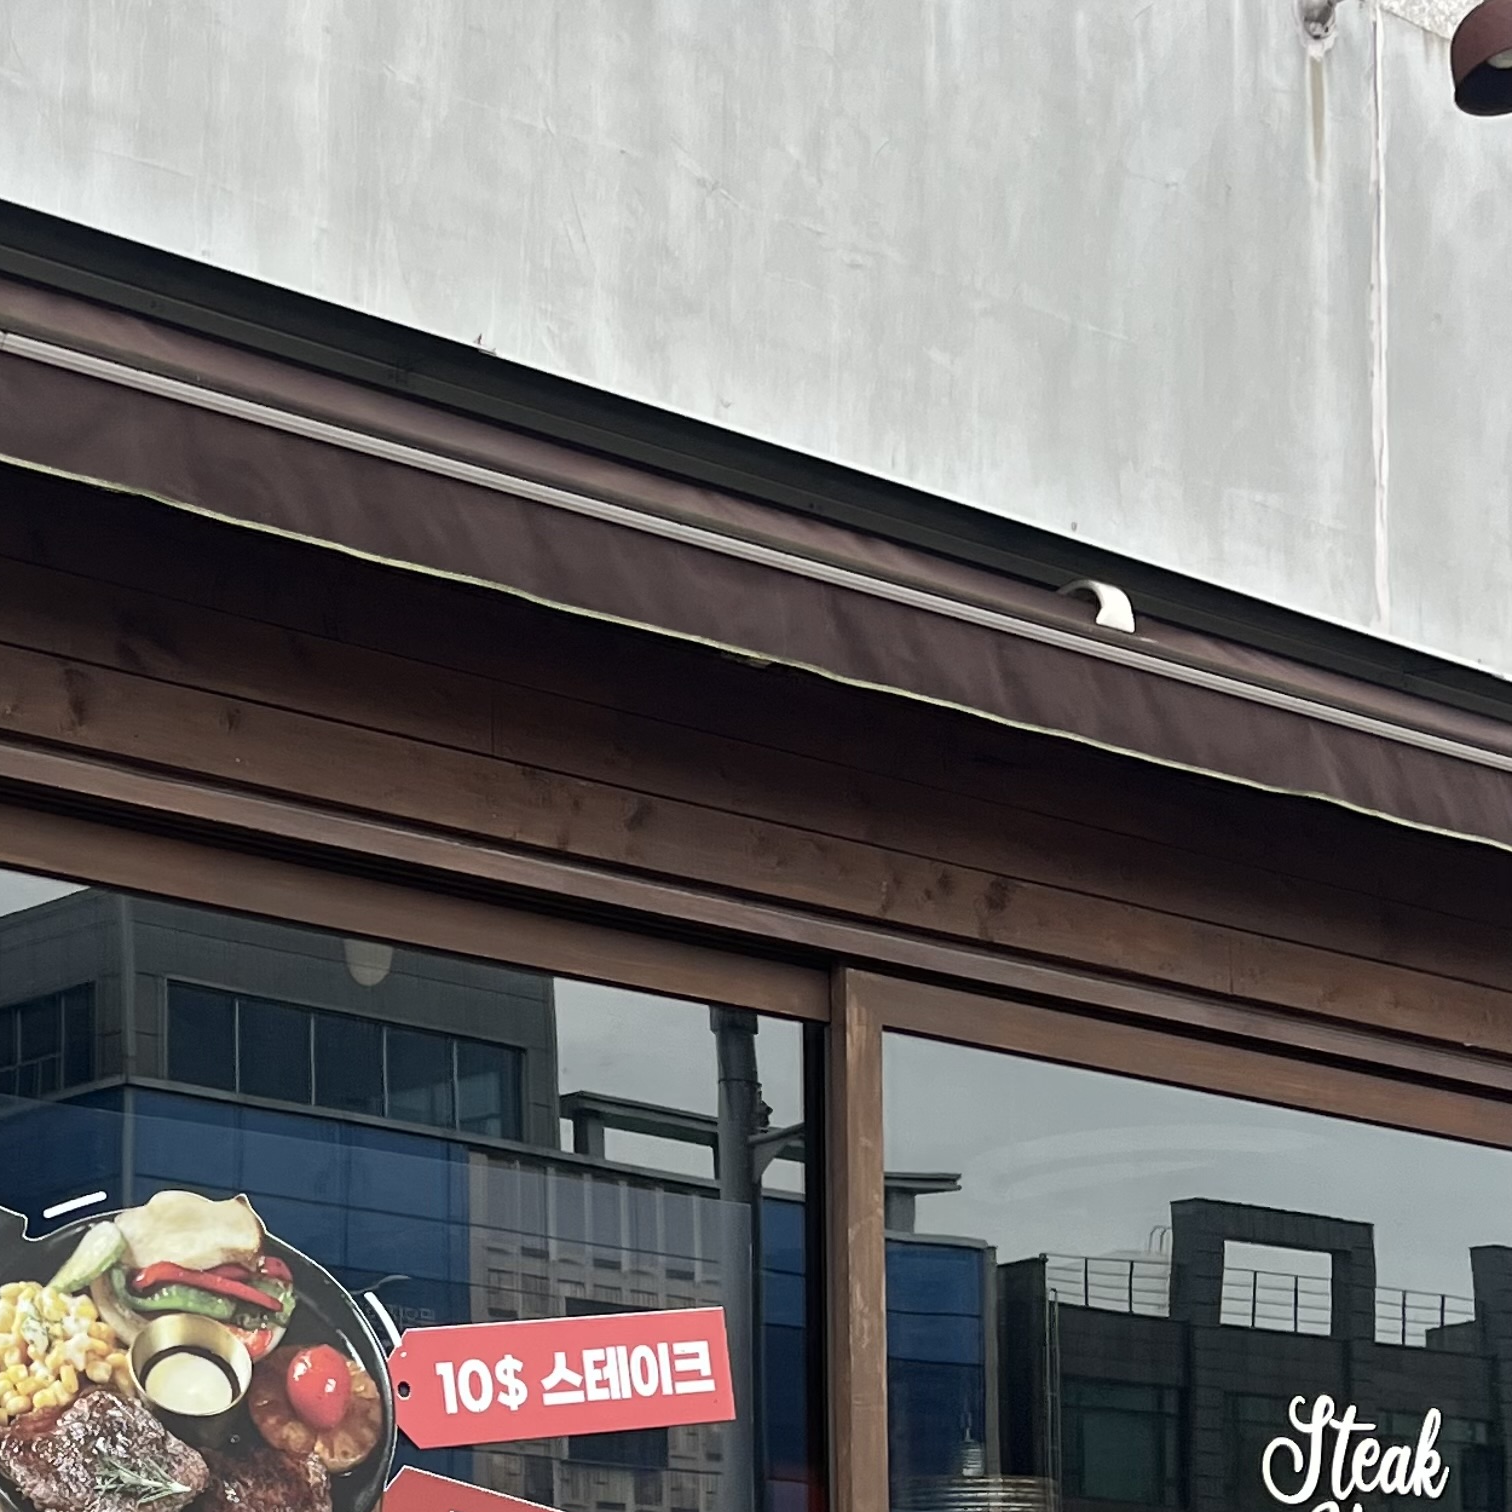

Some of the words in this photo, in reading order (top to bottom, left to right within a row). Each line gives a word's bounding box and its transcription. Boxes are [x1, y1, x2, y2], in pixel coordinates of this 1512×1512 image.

[435, 1354, 528, 1414] 10$
[540, 1340, 716, 1406] 스테이크
[1262, 1394, 1450, 1504] Steak
